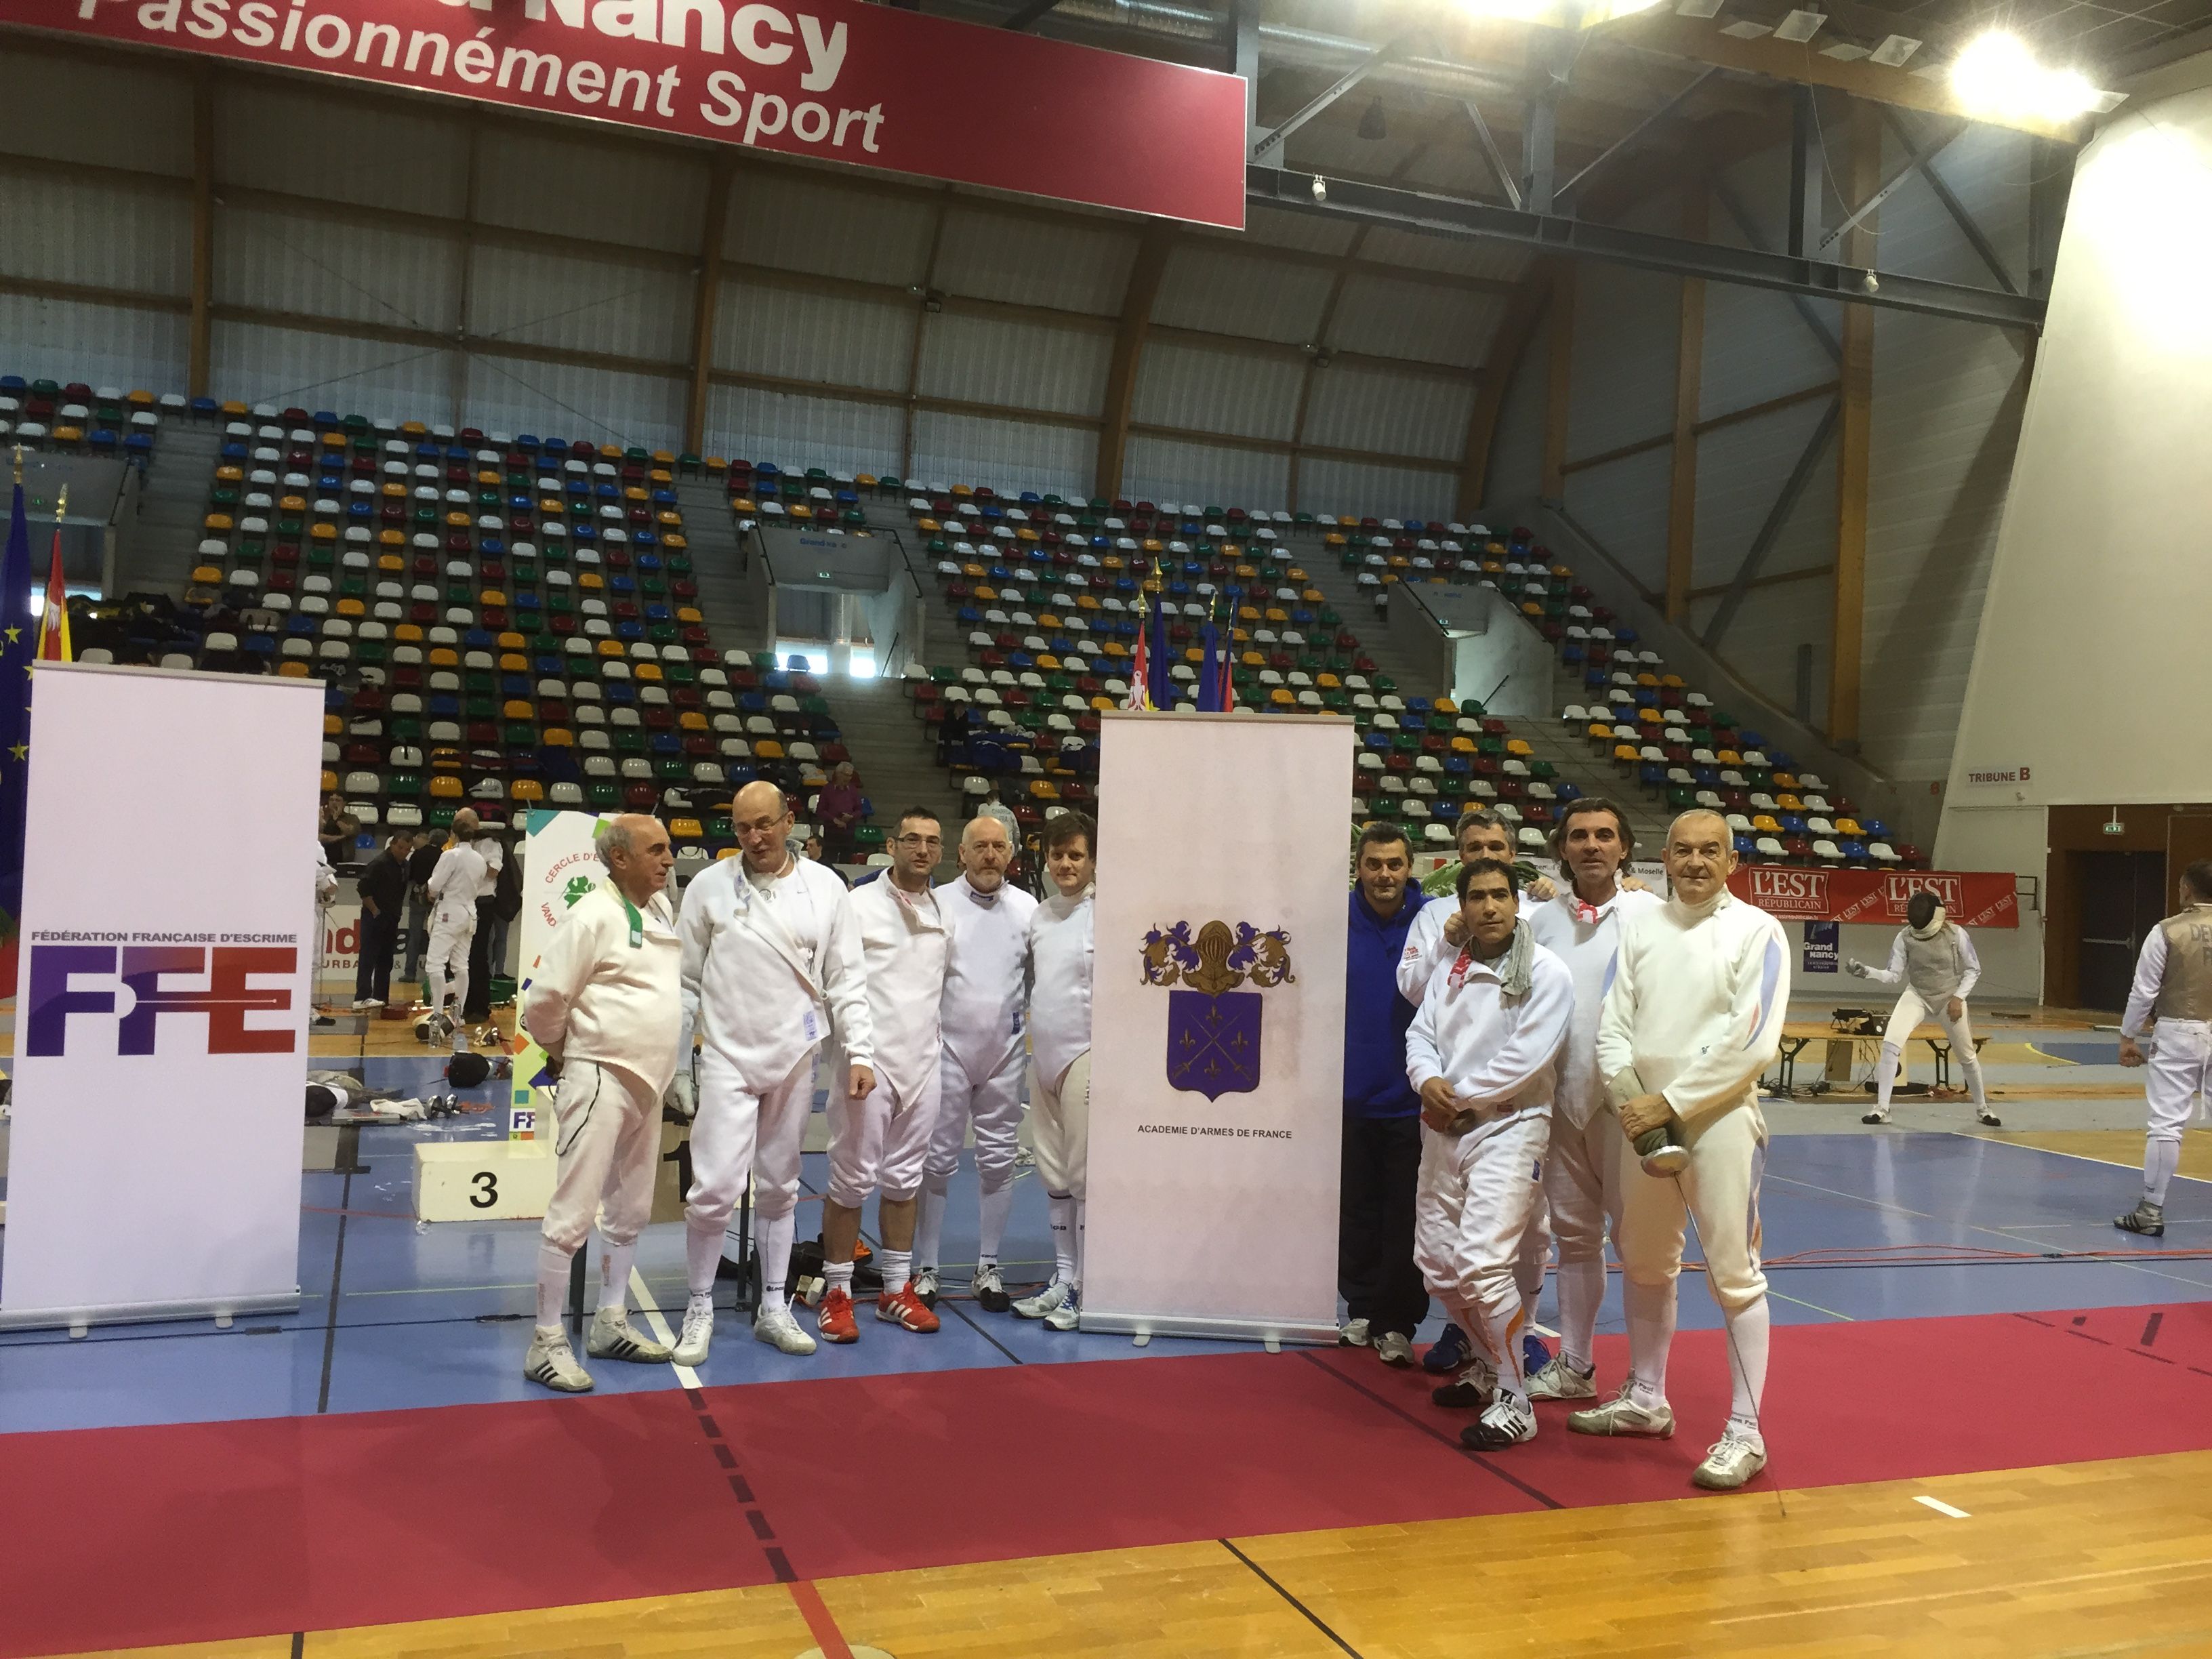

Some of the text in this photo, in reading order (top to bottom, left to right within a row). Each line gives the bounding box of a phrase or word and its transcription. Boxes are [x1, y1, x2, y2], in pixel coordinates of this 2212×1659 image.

[525, 0, 848, 92] ancy
[700, 69, 884, 153] Sport
[1968, 766, 2030, 783] TRIBUNE B
[545, 853, 581, 884] CERCLE
[1637, 867, 1664, 876] Moselle
[1753, 871, 1825, 898] L'EST
[1758, 897, 1822, 909] RÉPUBLICAIN
[31, 929, 297, 944] FÉDÉRATION FRANÇAISE D'ESCRIME
[1803, 941, 1833, 951] Grand
[1809, 951, 1839, 960] Nancy
[26, 945, 298, 1057] FFE
[513, 1111, 535, 1129] FF
[1137, 1125, 1292, 1139] ACADEMIE D'ARMES DE FRANCE
[663, 1141, 692, 1202] 1
[470, 1171, 498, 1208] 3
